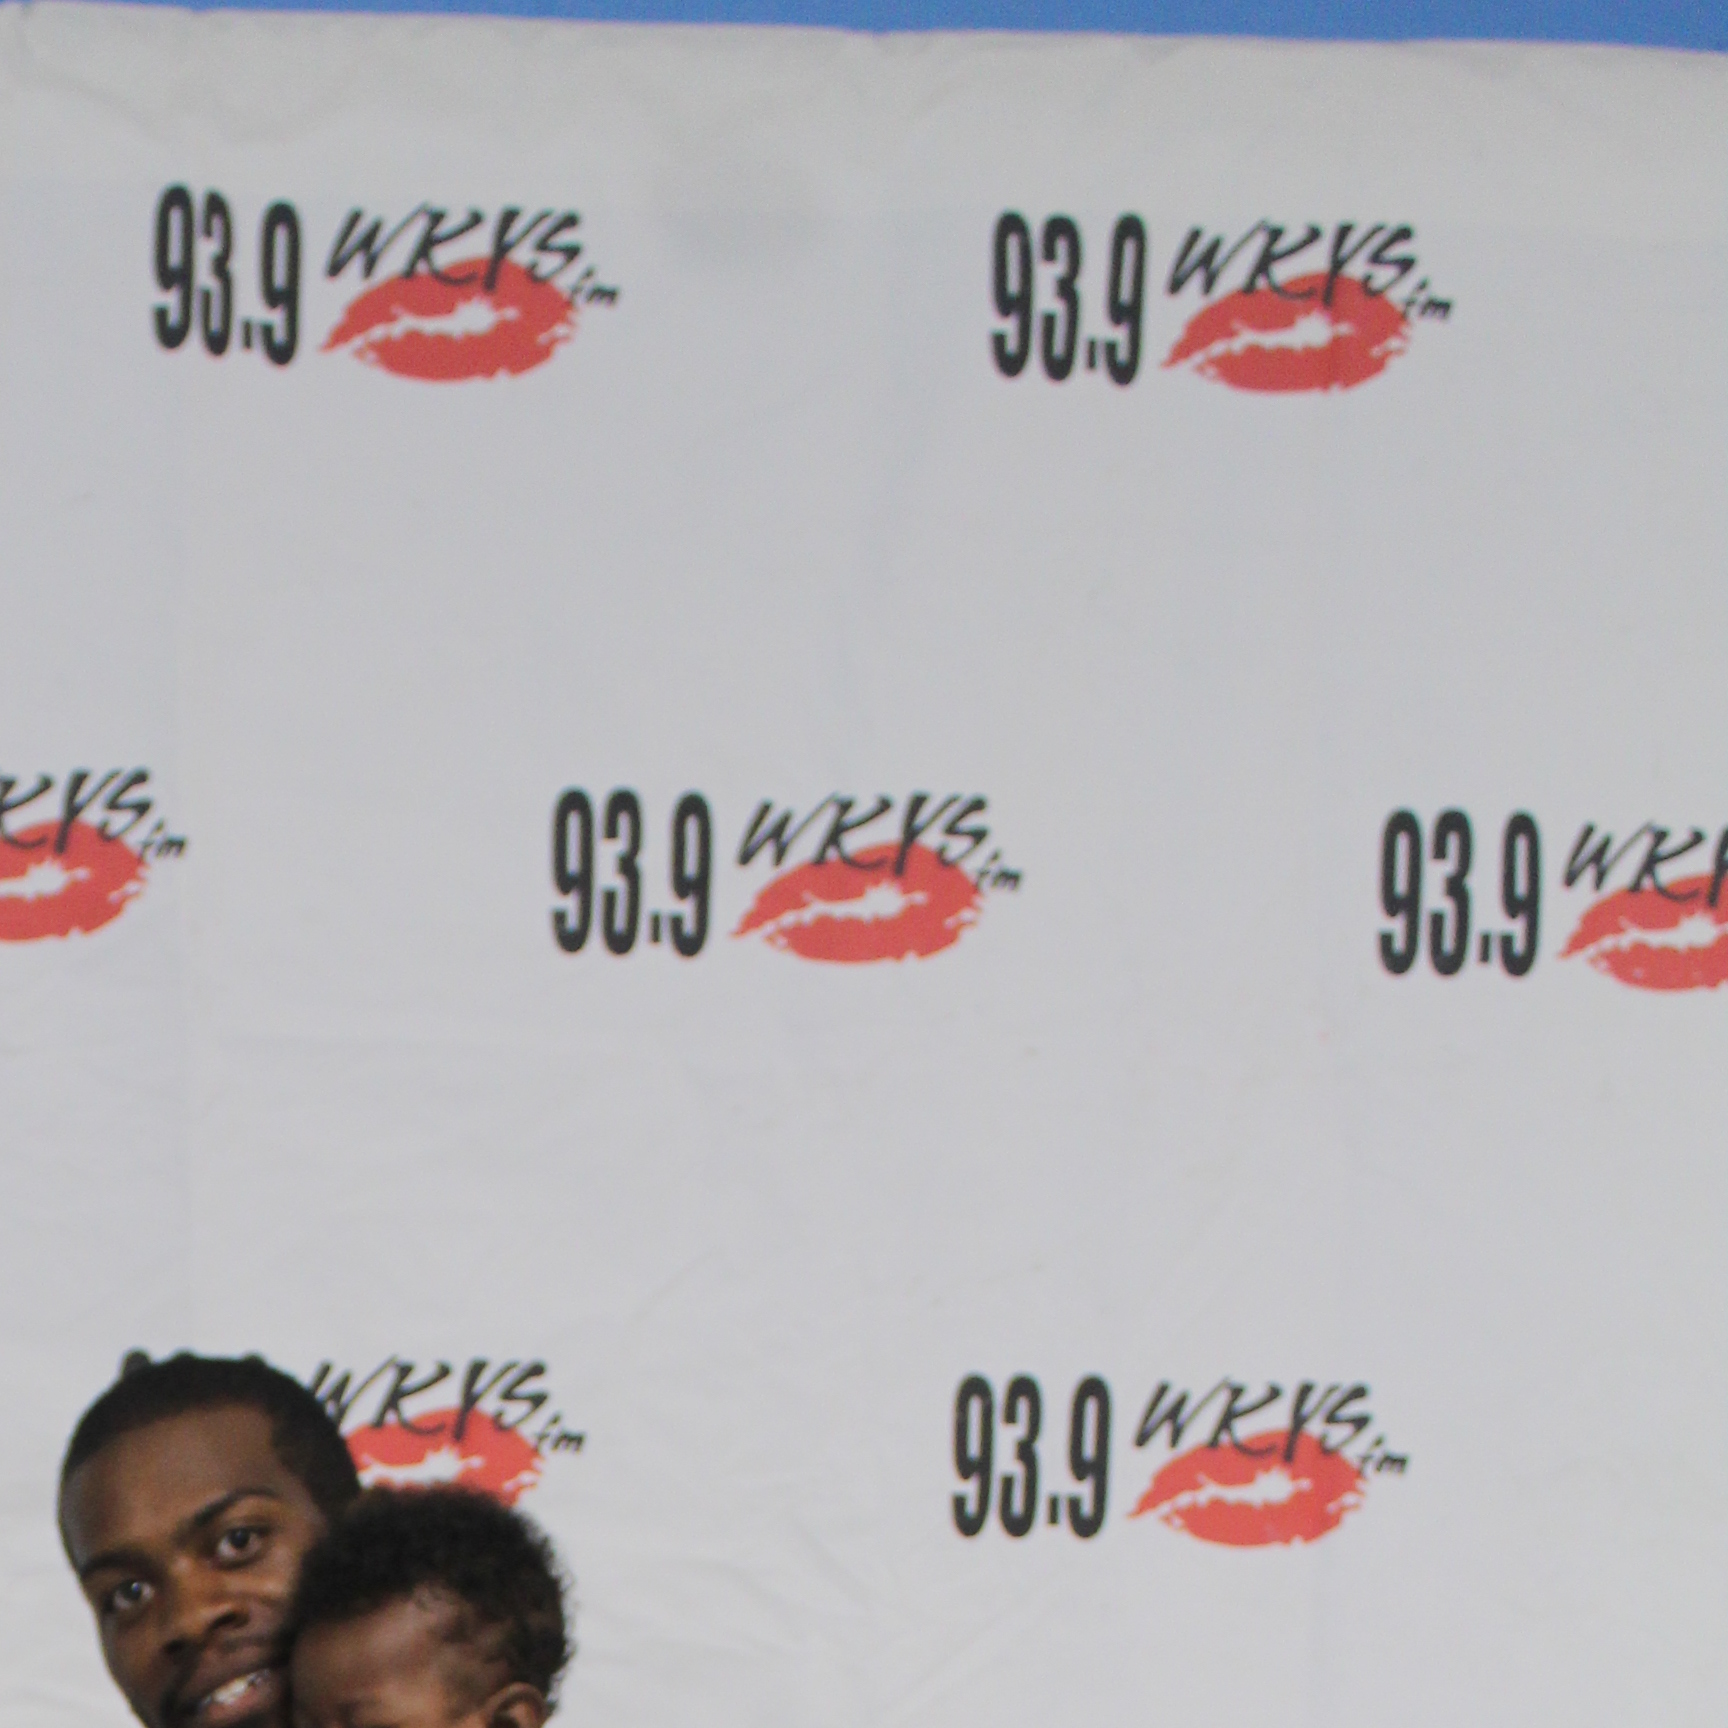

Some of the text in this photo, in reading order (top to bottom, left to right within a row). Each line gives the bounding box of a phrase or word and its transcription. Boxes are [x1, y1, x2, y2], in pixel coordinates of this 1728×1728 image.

[153, 182, 303, 366] 93.9
[325, 204, 583, 292] WKYS
[991, 210, 1148, 386] 93.9
[1168, 220, 1417, 308] WKYS
[553, 787, 713, 957] 93.9
[738, 792, 989, 876] WKYS
[1380, 808, 1728, 977] 93.9 WK
[953, 1374, 1112, 1538] 93.9
[1135, 1382, 1372, 1462] WKYS
